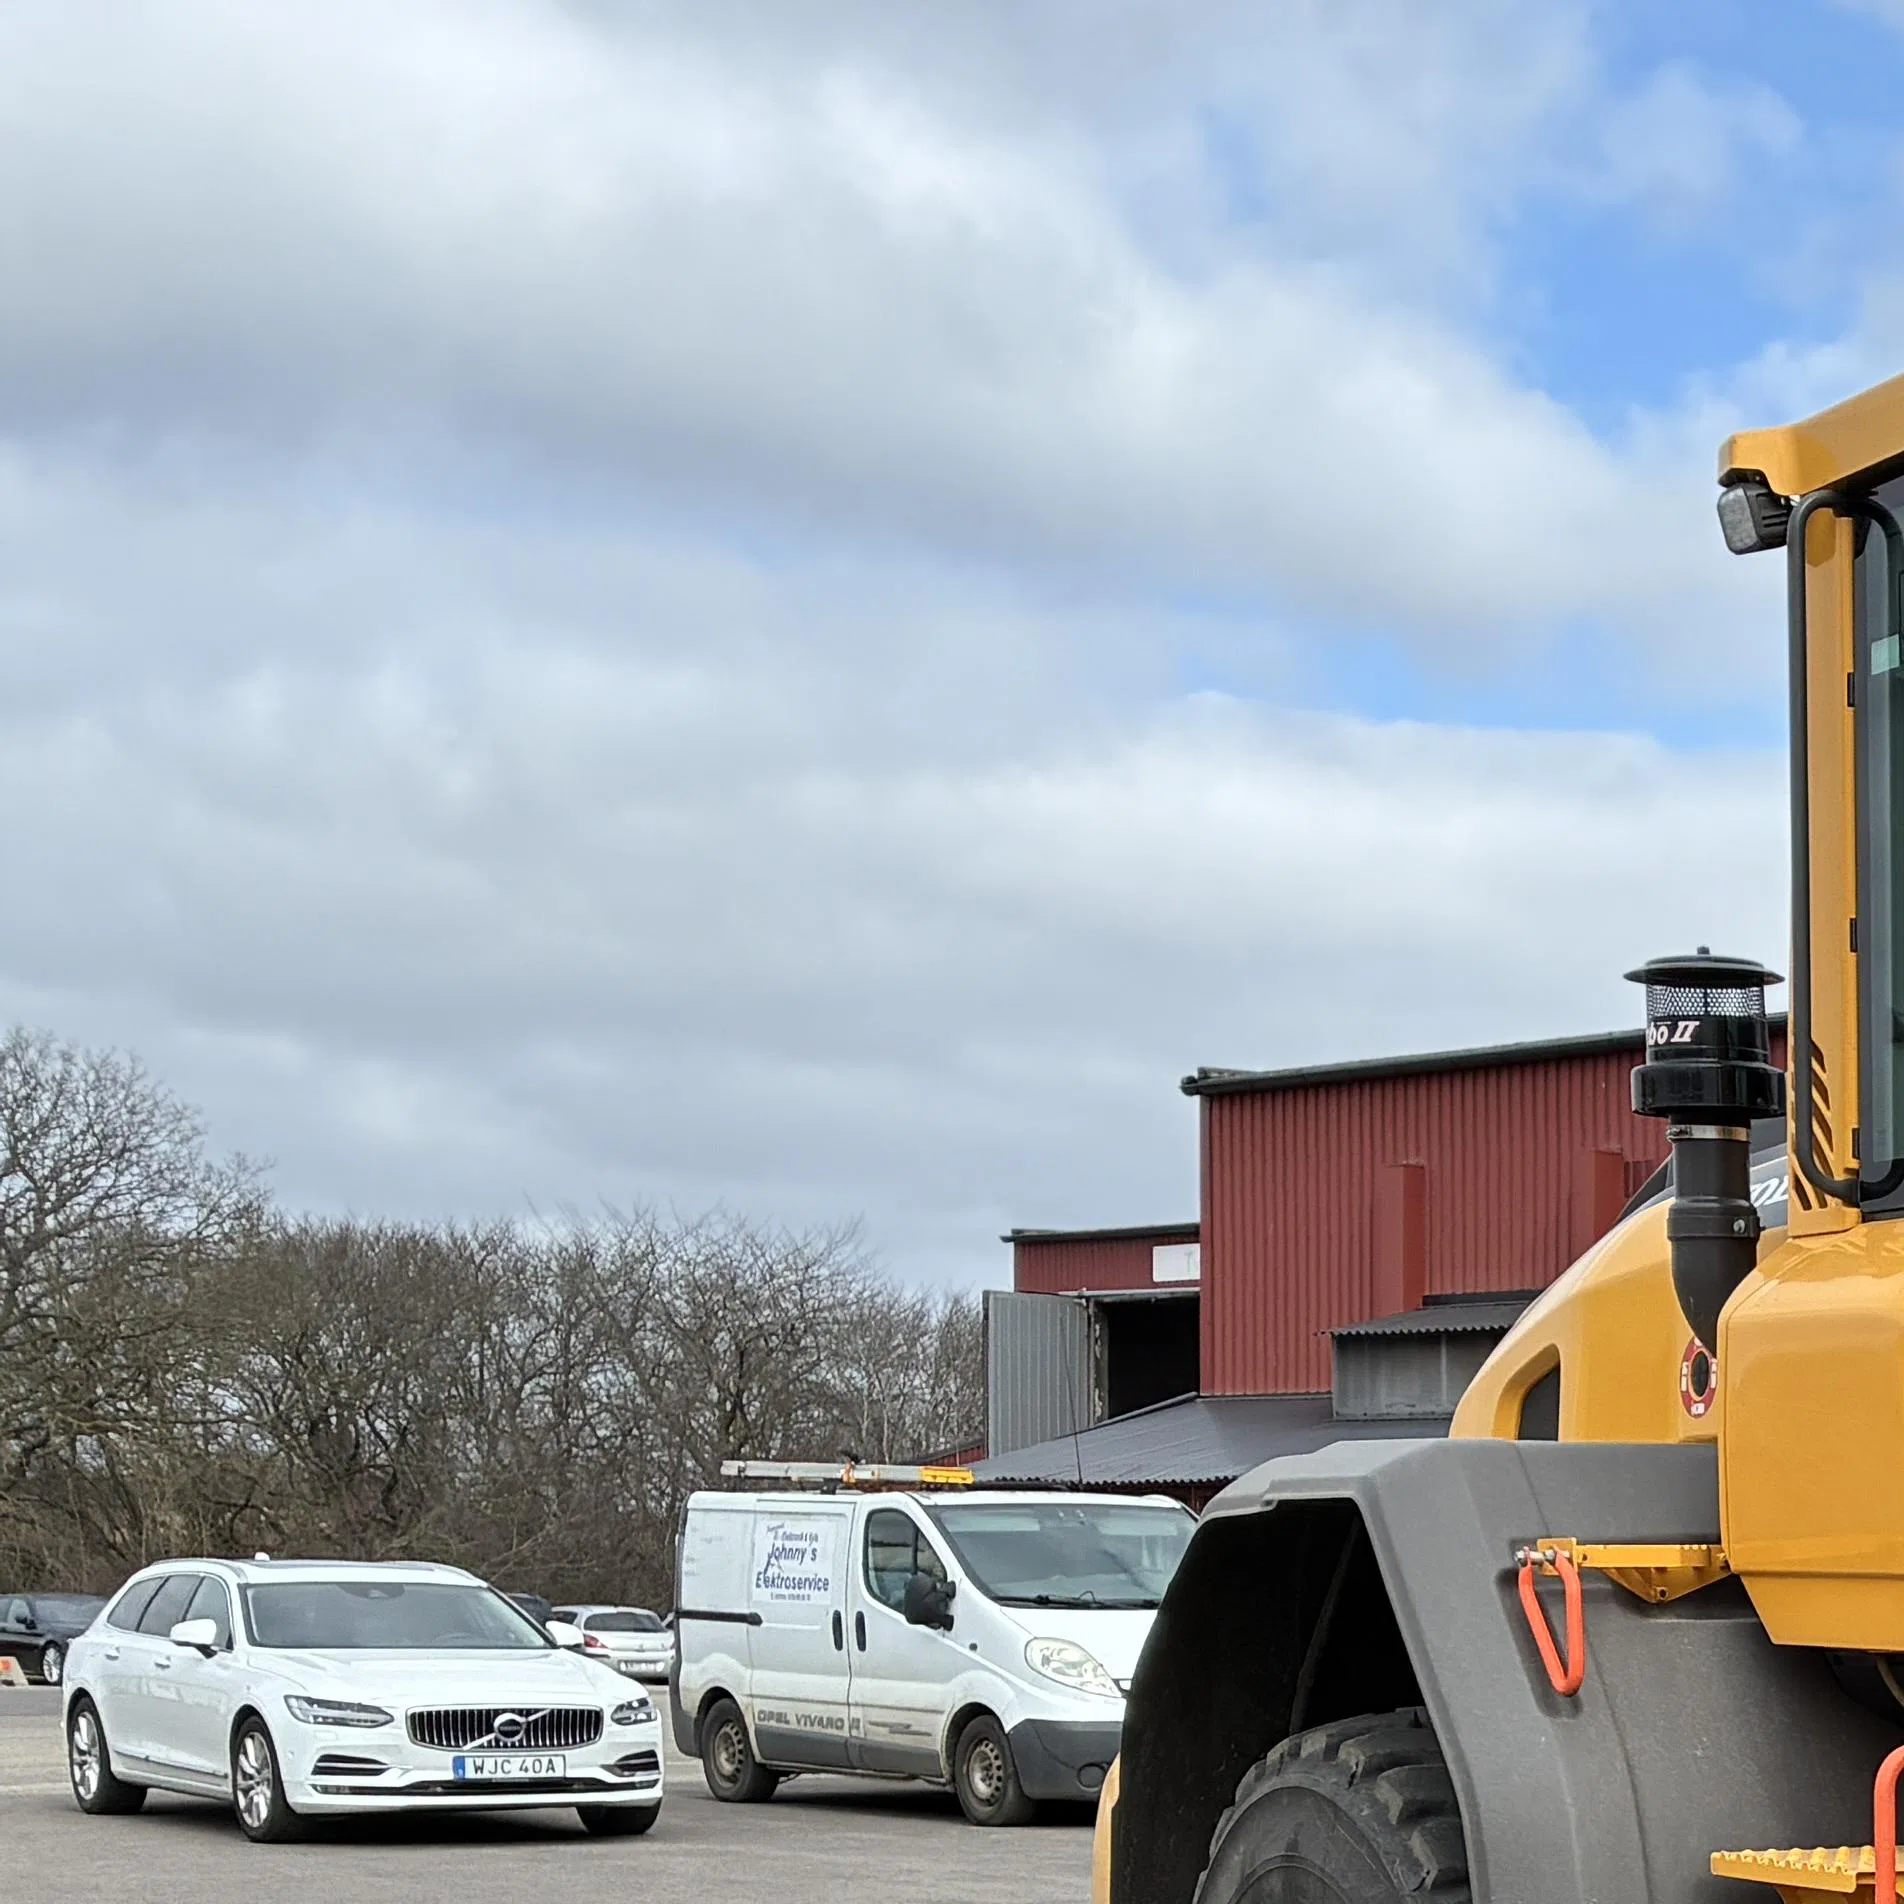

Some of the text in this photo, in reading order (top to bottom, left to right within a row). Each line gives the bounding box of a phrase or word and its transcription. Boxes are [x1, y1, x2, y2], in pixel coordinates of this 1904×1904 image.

[757, 1709, 791, 1725] OPEL
[795, 1713, 845, 1731] VIVARO
[473, 1758, 556, 1775] WJC 40A
